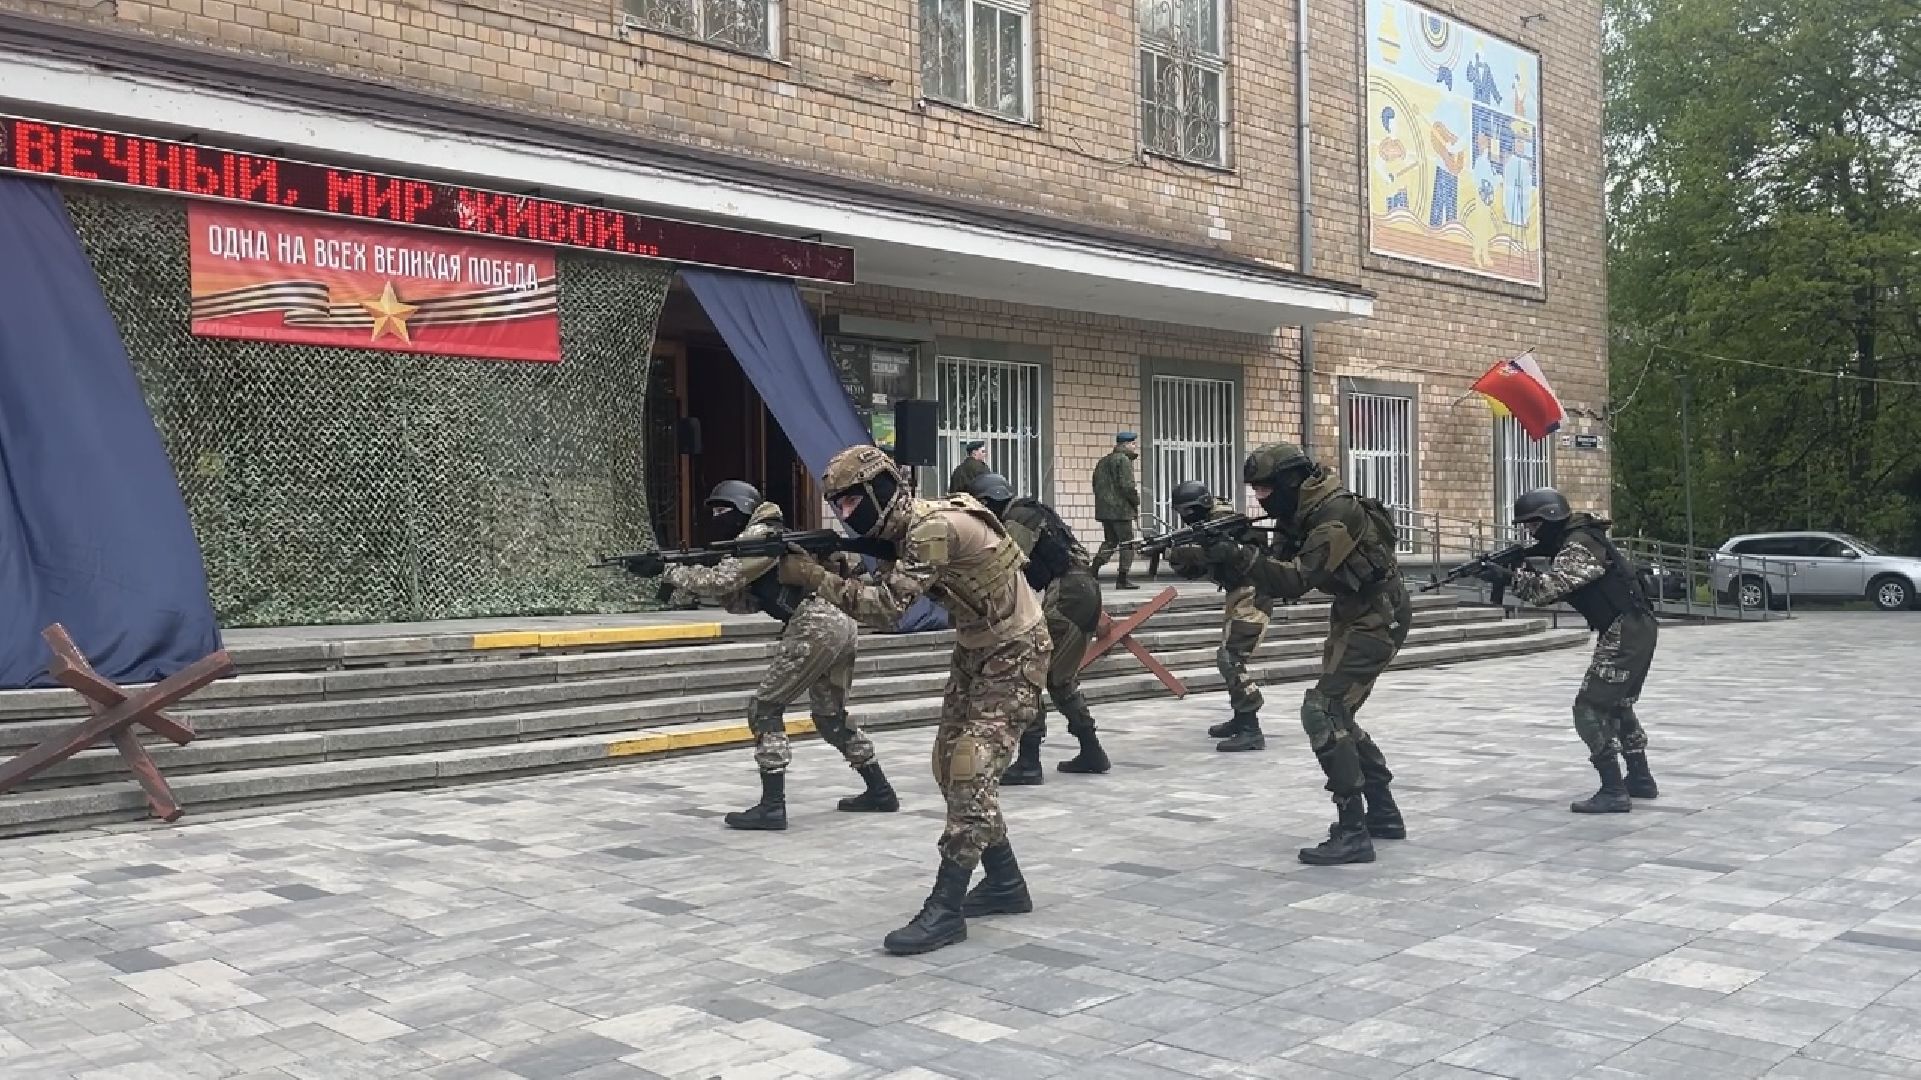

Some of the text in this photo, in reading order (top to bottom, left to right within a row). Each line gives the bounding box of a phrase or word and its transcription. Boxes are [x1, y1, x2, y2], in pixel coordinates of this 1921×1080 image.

[15, 121, 659, 256] ВЕЧНЫЙ, МИР ЖИВОЙ...
[209, 224, 539, 291] ОДНА НА ВСЕХ ВЕЛИКАЯ ПОБЕДА
